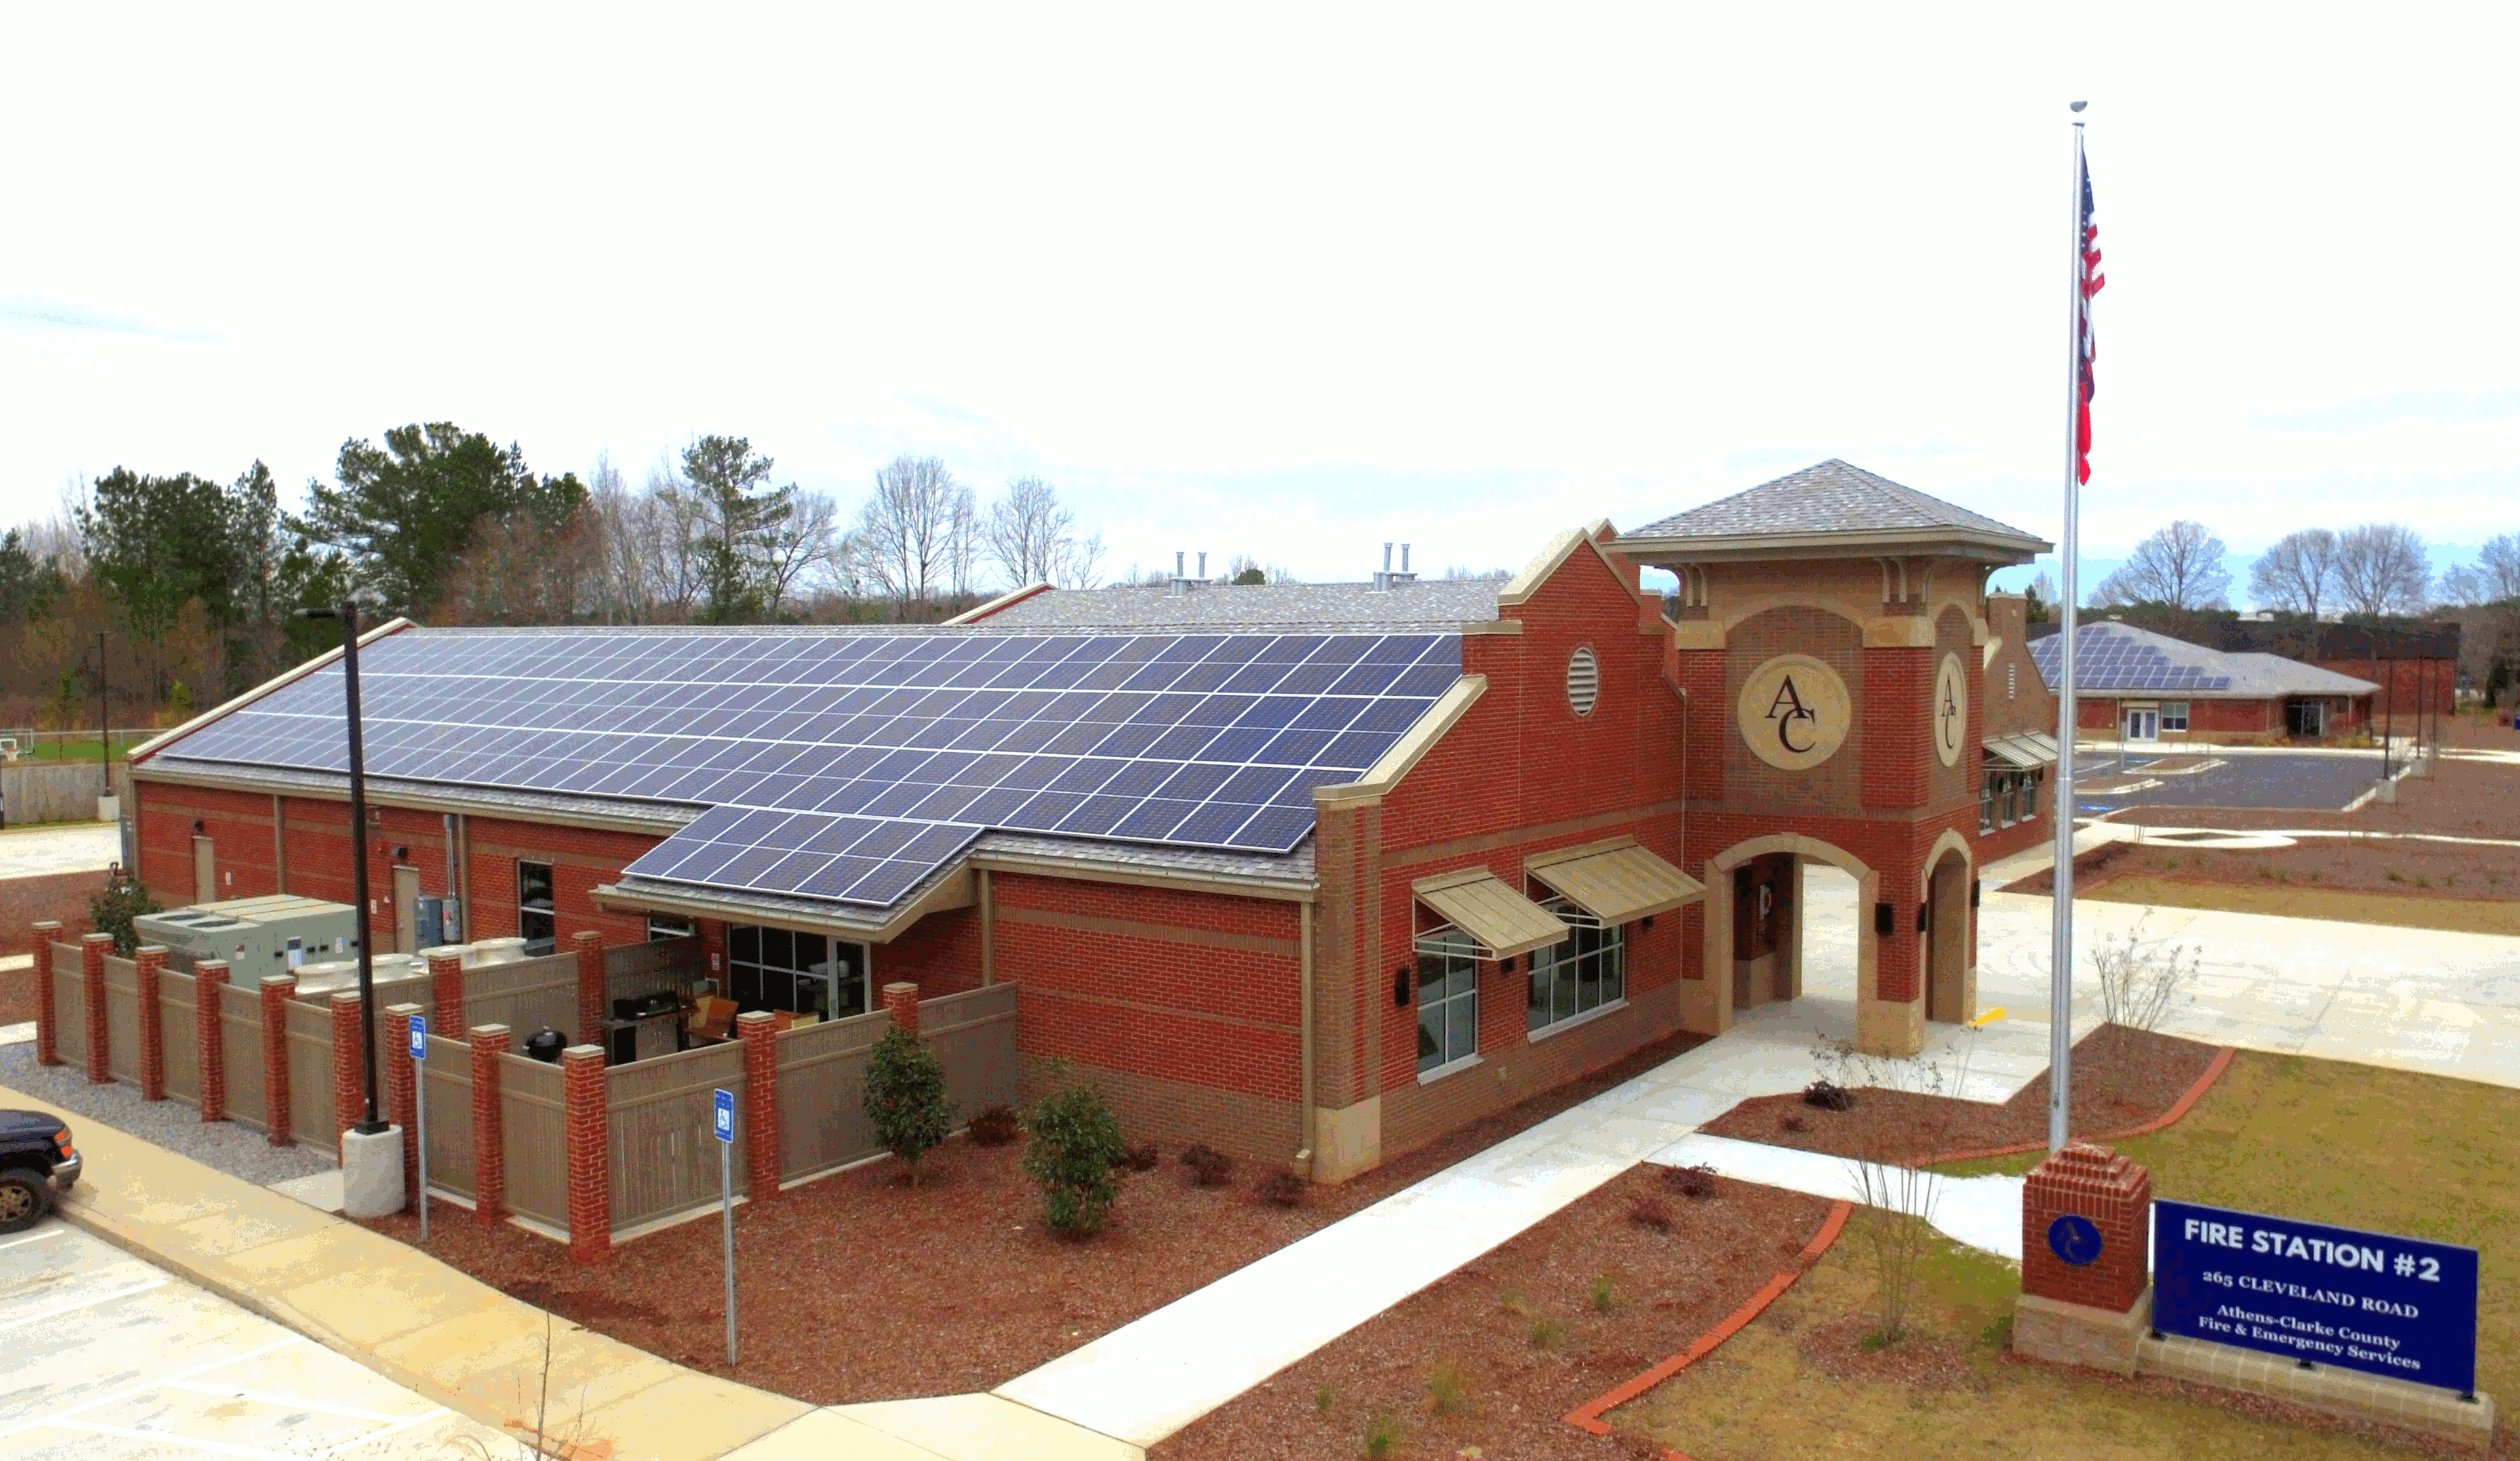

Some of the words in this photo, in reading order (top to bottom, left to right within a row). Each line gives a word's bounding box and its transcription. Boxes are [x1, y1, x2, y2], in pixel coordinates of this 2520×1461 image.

[2184, 1218, 2243, 1249] FIRE
[2251, 1230, 2384, 1273] STATION
[2393, 1252, 2441, 1283] #2
[2202, 1271, 2234, 1288] 265
[2238, 1275, 2356, 1307] CLEVELAND
[2361, 1296, 2419, 1319] ROAD
[2199, 1315, 2232, 1333] Fire
[2234, 1323, 2247, 1336] &
[2252, 1325, 2344, 1357] Emergency
[2347, 1344, 2421, 1371] Services
[2216, 1304, 2334, 1336] Athens-Clarke
[2338, 1327, 2401, 1351] County
